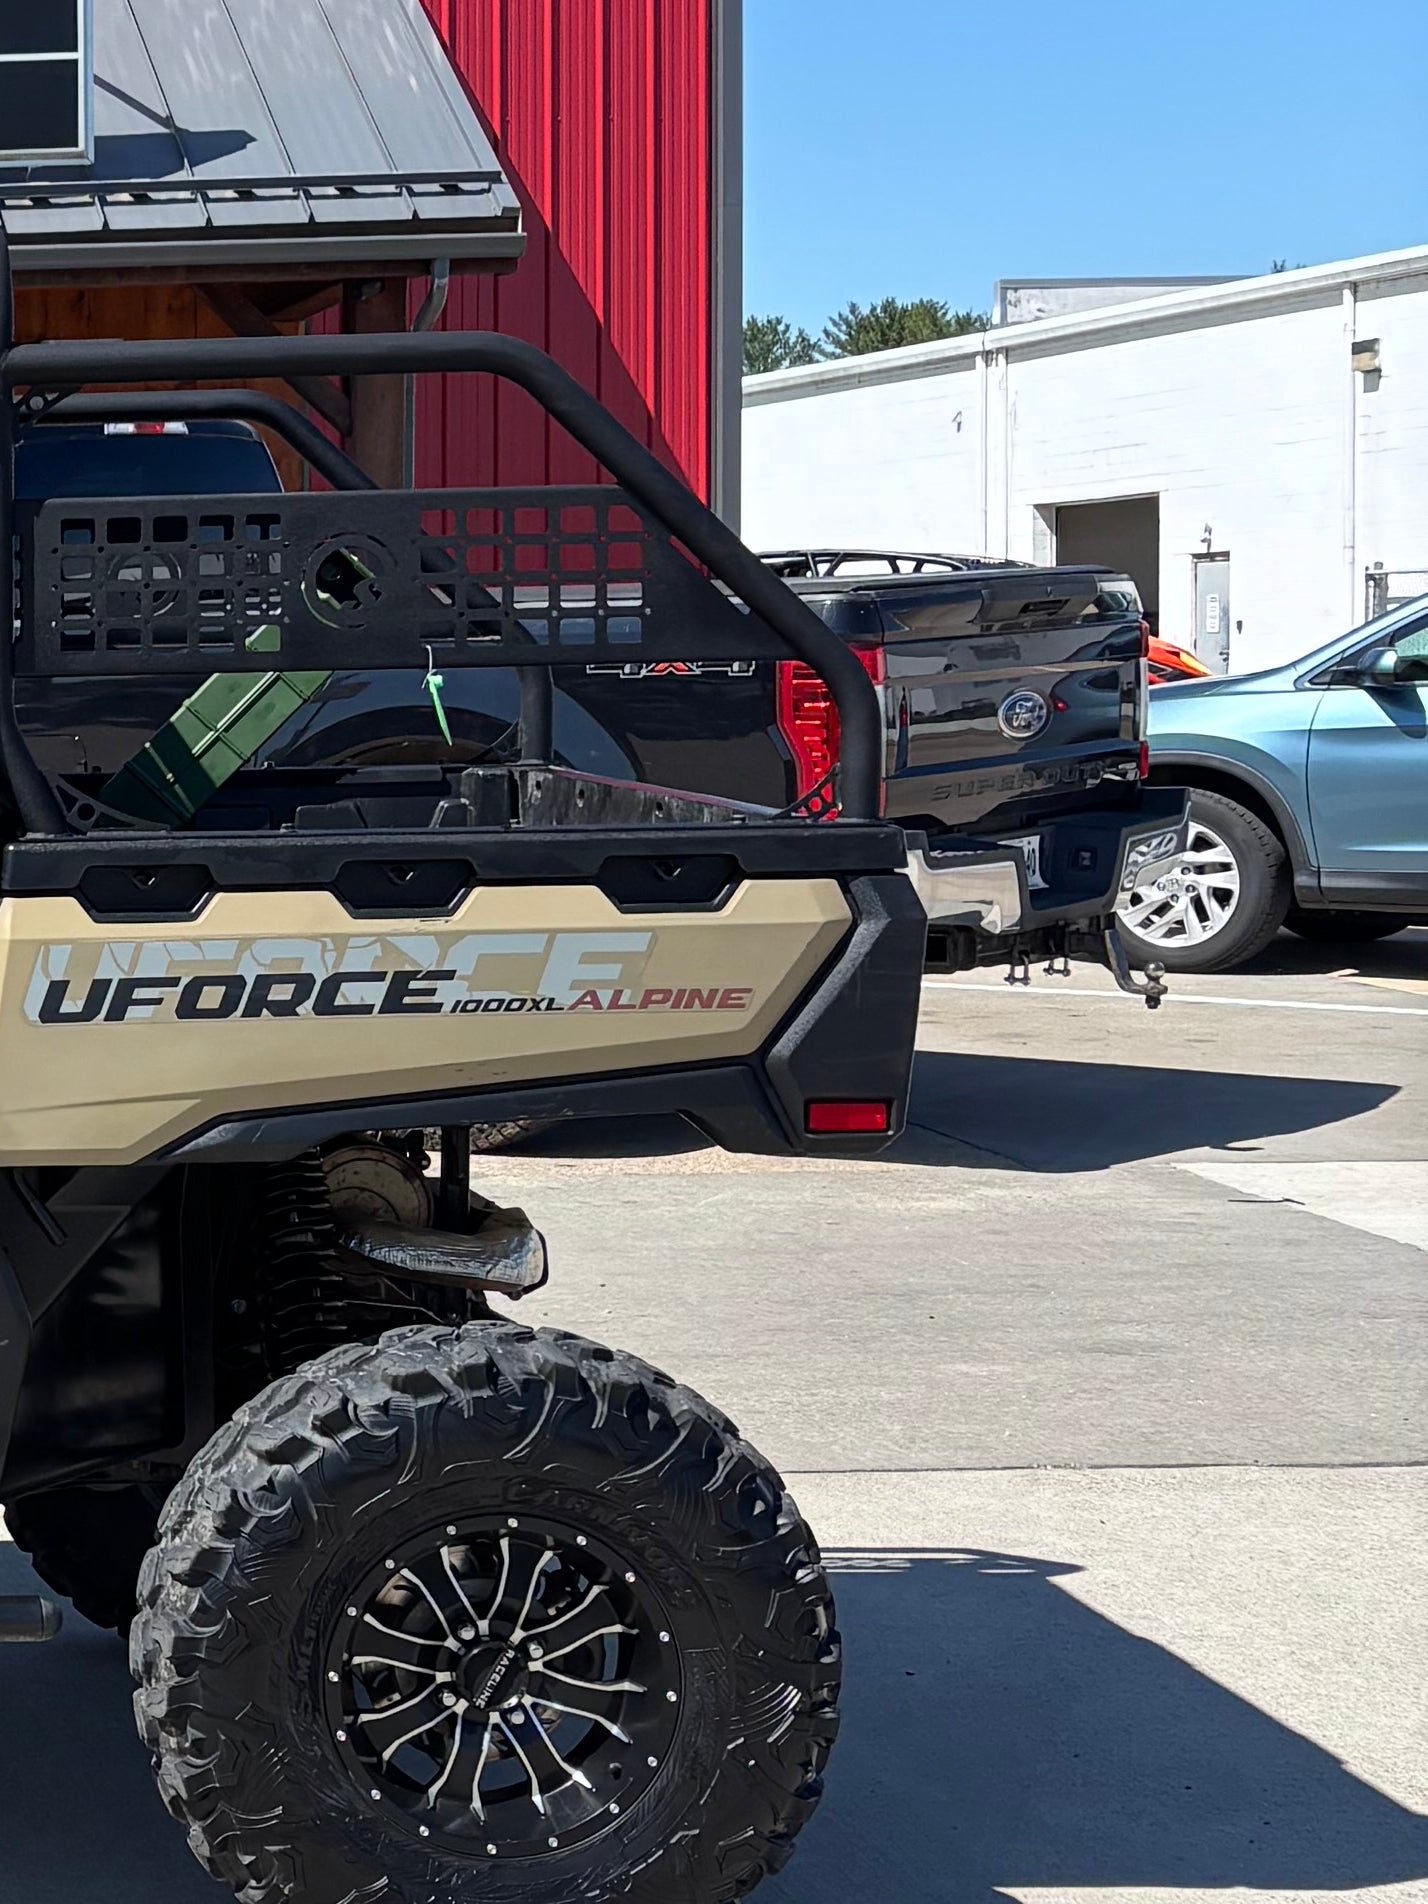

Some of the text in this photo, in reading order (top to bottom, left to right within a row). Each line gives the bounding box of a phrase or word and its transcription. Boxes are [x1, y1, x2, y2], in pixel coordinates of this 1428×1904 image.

[39, 969, 754, 1024] UFORCE 1000XL ALPINE
[474, 1649, 515, 1709] RACELINE
